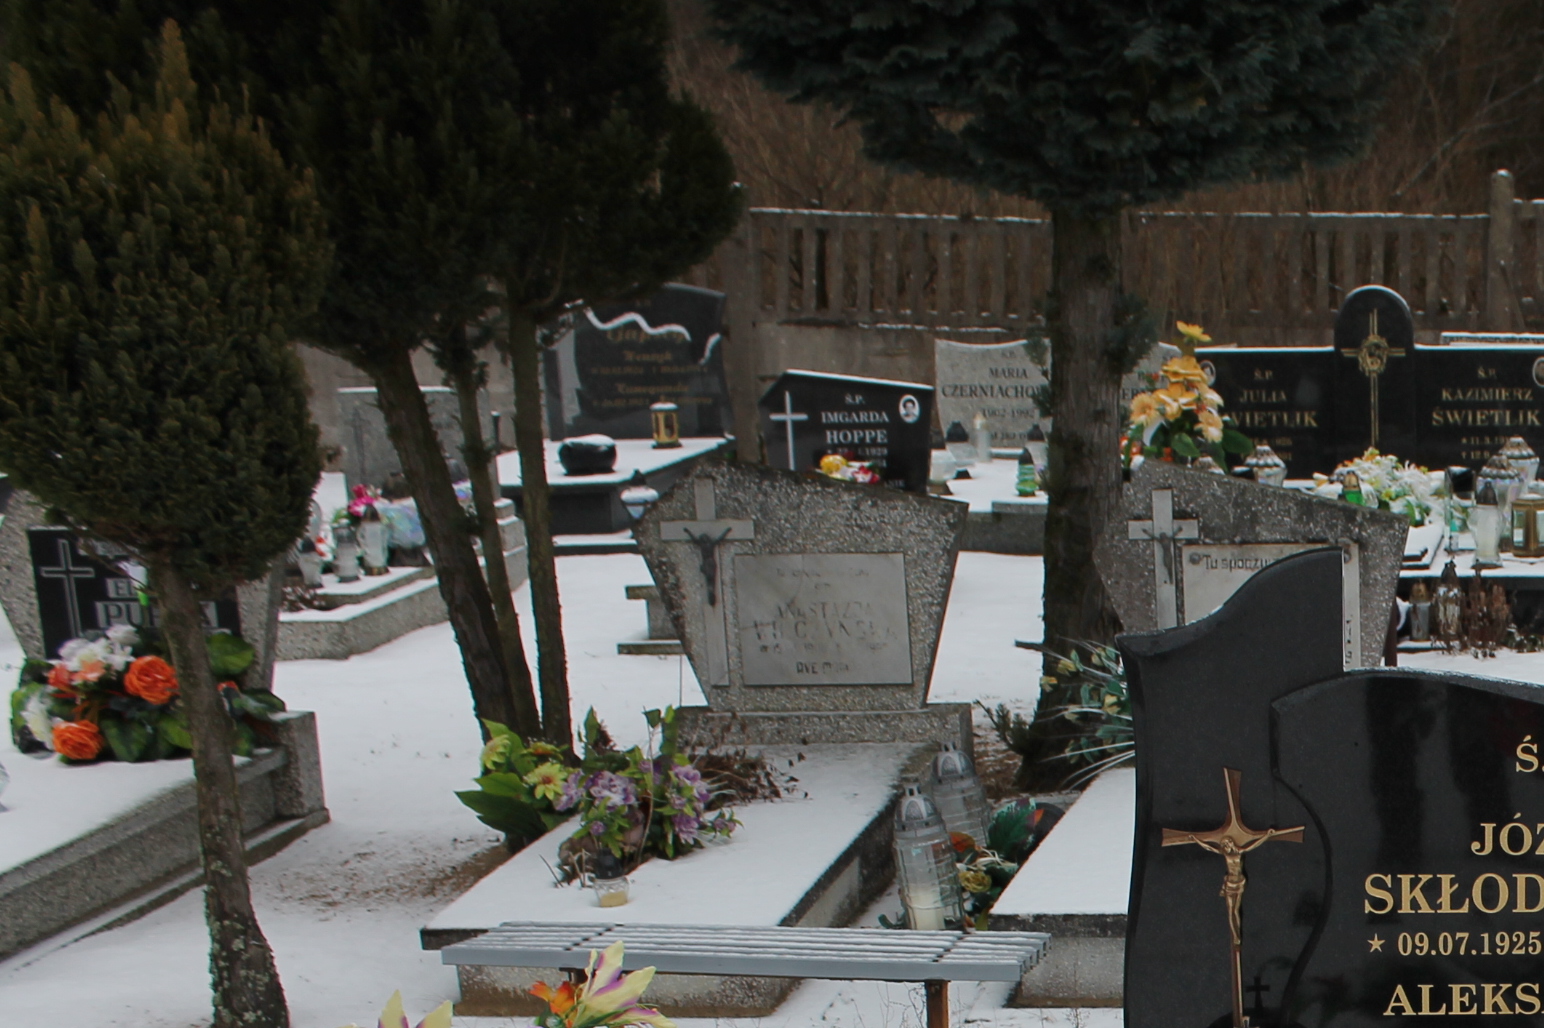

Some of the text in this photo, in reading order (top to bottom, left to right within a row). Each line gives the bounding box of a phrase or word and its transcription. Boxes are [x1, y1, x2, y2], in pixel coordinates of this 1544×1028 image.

[989, 367, 1029, 379] MARIA
[1441, 387, 1533, 401] KAZIMIERZ
[821, 411, 890, 424] IMGARDA
[1432, 406, 1542, 427] ŚWIETLIK
[826, 429, 889, 445] HOPPE
[1397, 931, 1542, 956] 09.07.1925
